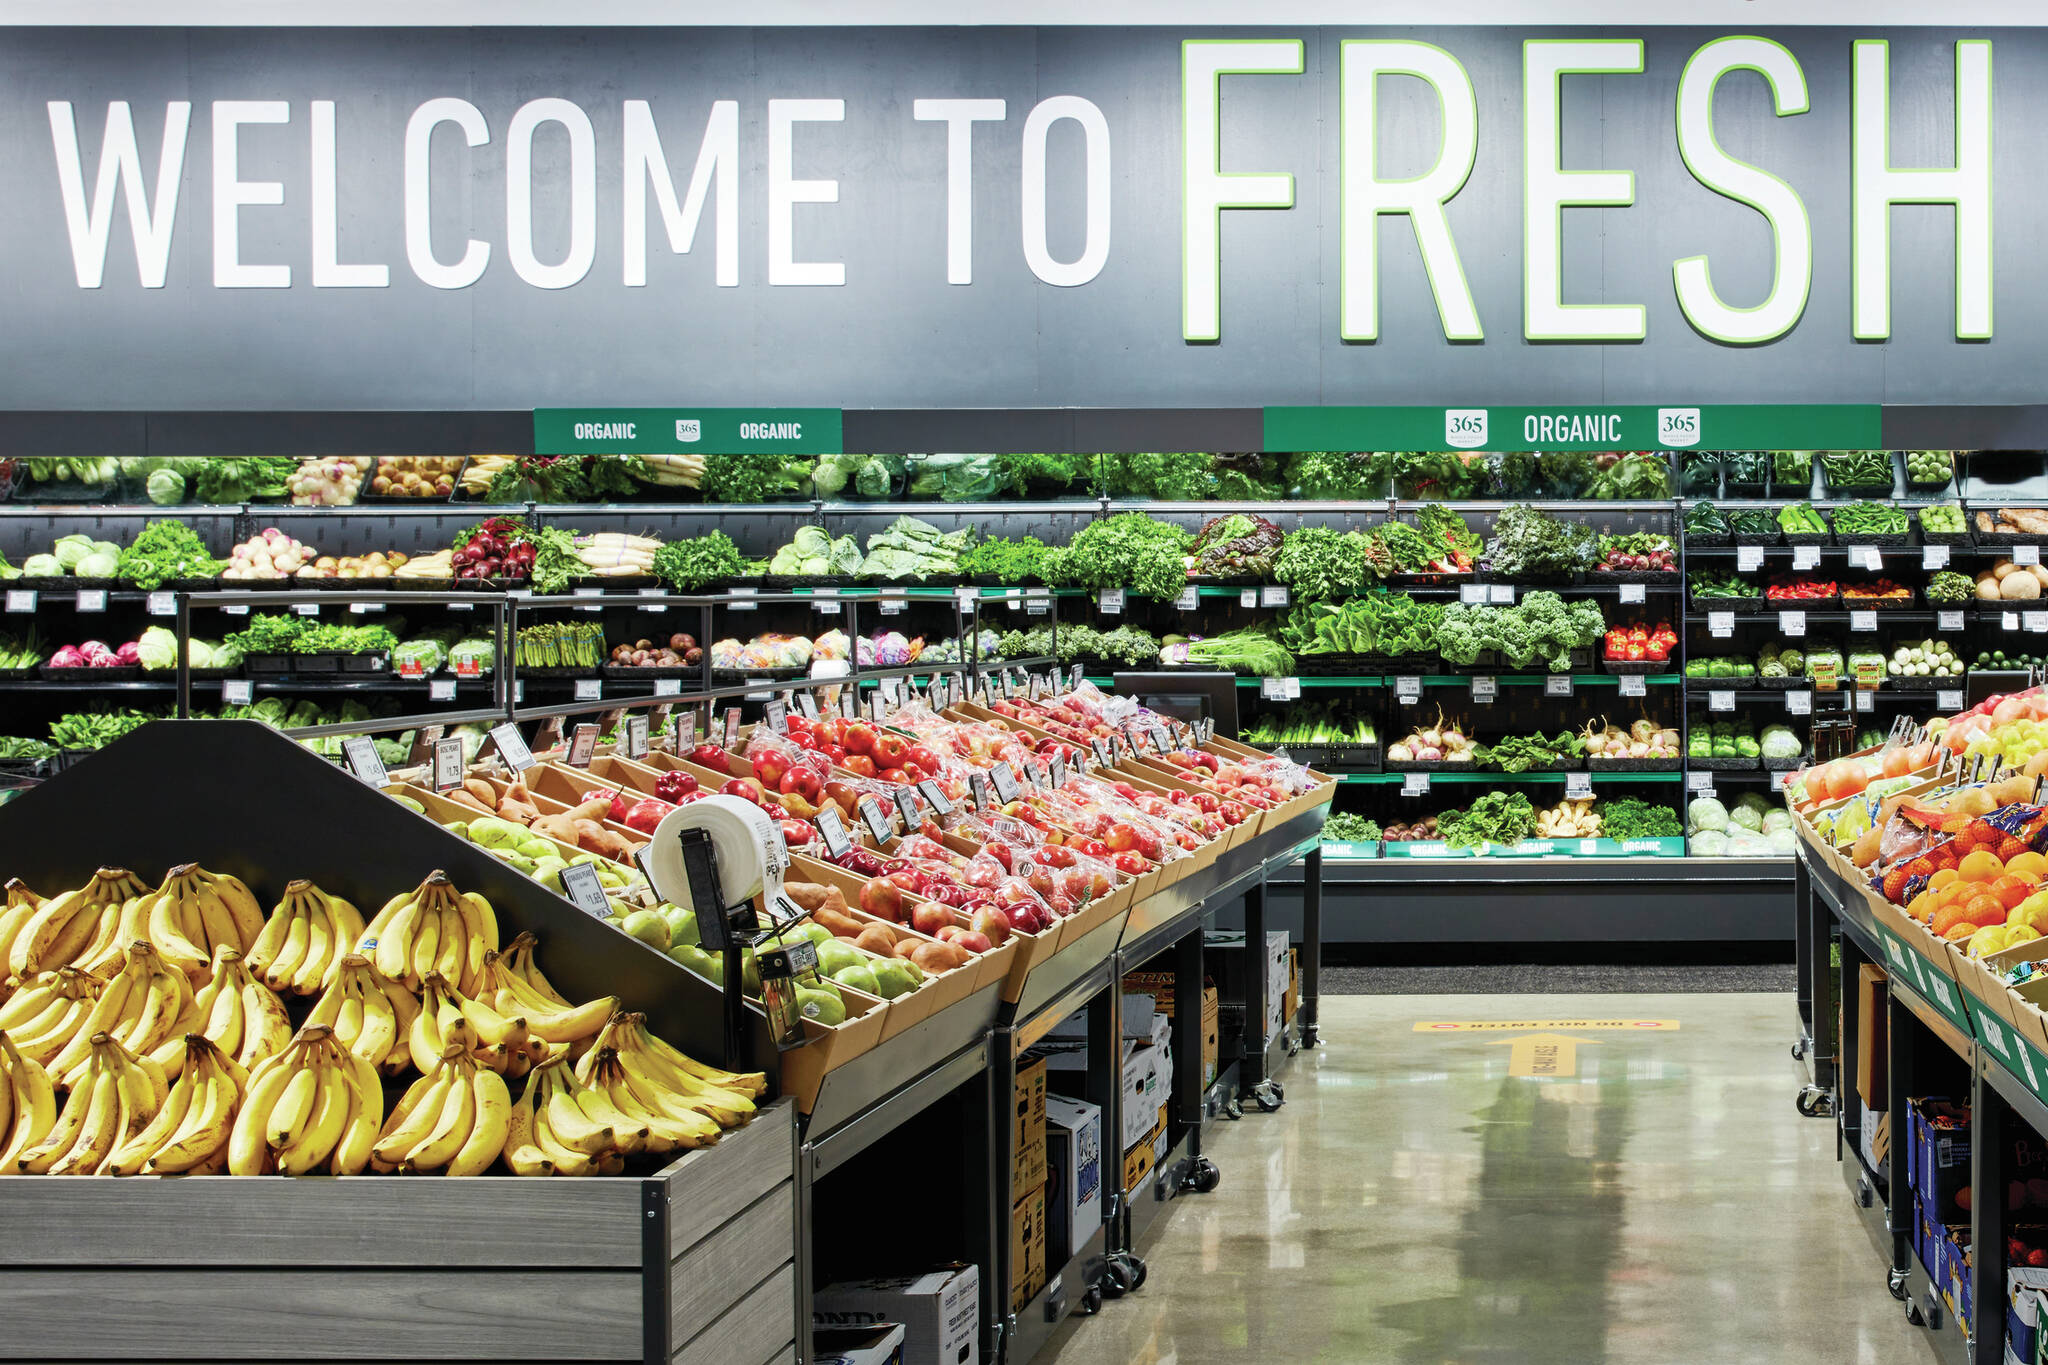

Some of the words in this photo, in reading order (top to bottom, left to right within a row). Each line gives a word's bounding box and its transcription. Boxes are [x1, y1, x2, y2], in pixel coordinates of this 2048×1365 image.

[47, 96, 847, 289] WELCOME
[913, 95, 1112, 287] TO
[1181, 35, 1994, 345] FRESH
[574, 422, 637, 440] ORGANIC
[678, 423, 698, 433] 365
[739, 422, 802, 440] ORGANIC
[1450, 415, 1483, 434] 365
[1524, 414, 1623, 443] ORGANIC
[1663, 414, 1696, 433] 365
[1321, 844, 1353, 855] RGANIC
[1622, 840, 1661, 852] ORGANIC
